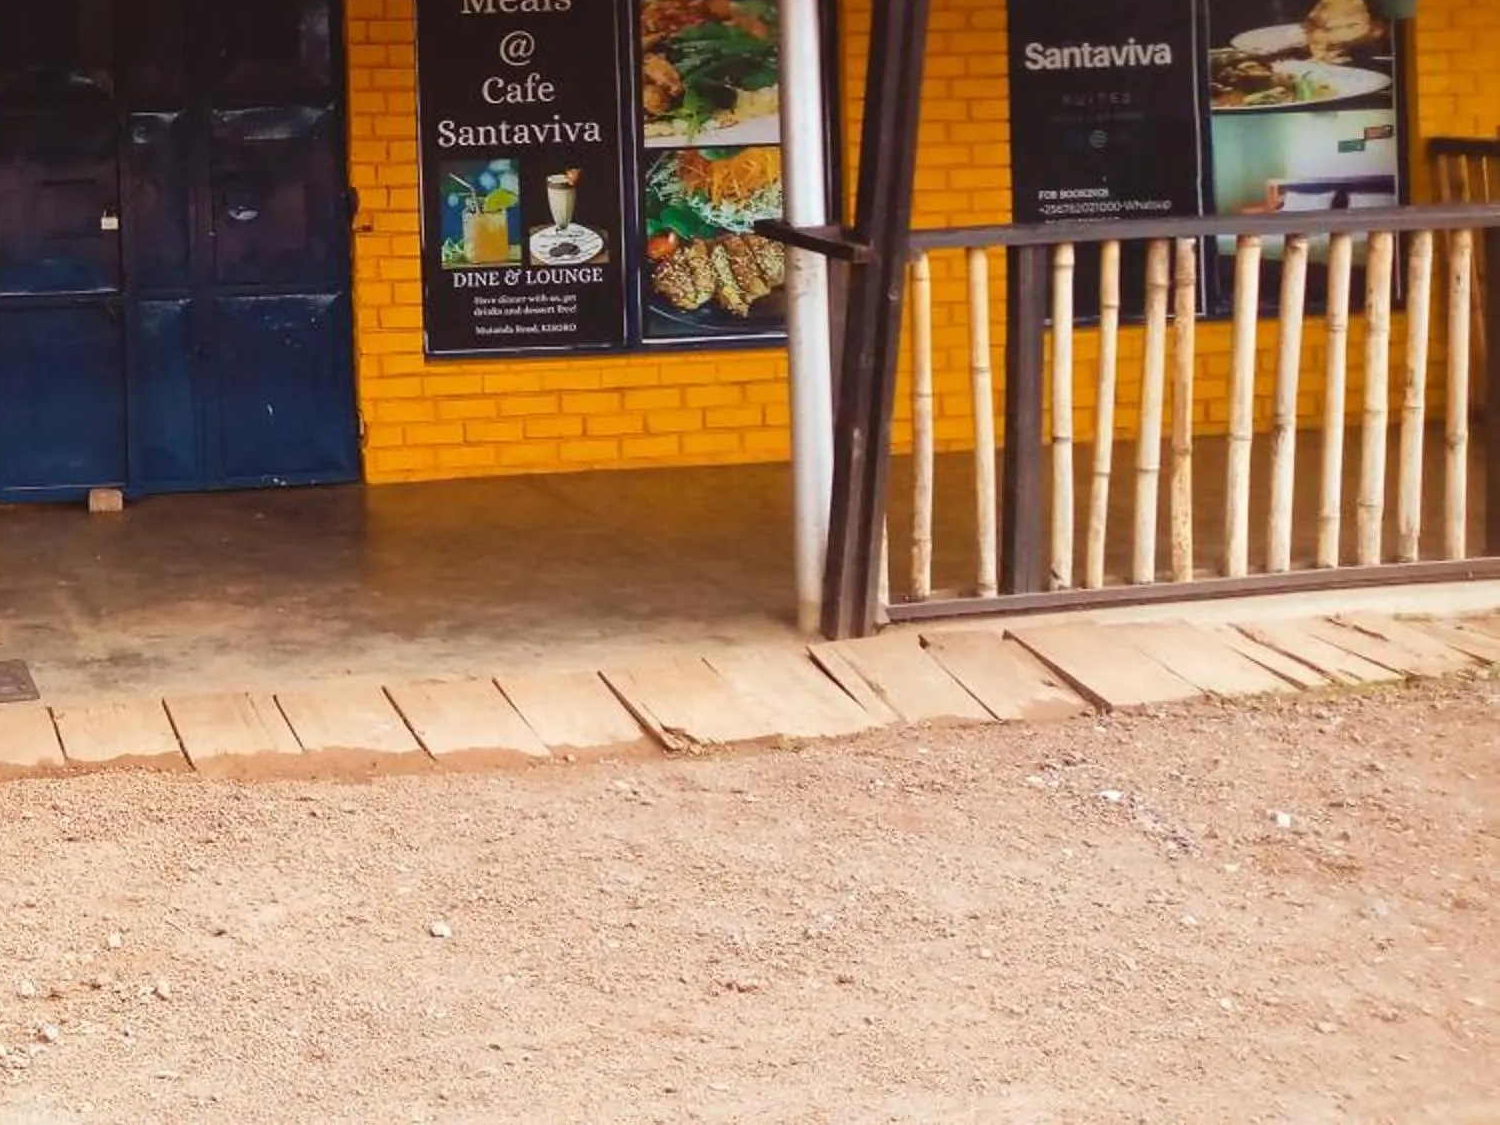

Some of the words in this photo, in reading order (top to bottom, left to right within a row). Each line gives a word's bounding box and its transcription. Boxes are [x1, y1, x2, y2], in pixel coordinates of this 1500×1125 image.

[499, 30, 536, 67] @
[1024, 36, 1173, 71] Santaviva
[482, 72, 557, 105] Cafe
[437, 114, 602, 148] Santaviva
[452, 271, 500, 288] DINE
[503, 269, 522, 286] &
[525, 267, 604, 284] LOUNGE
